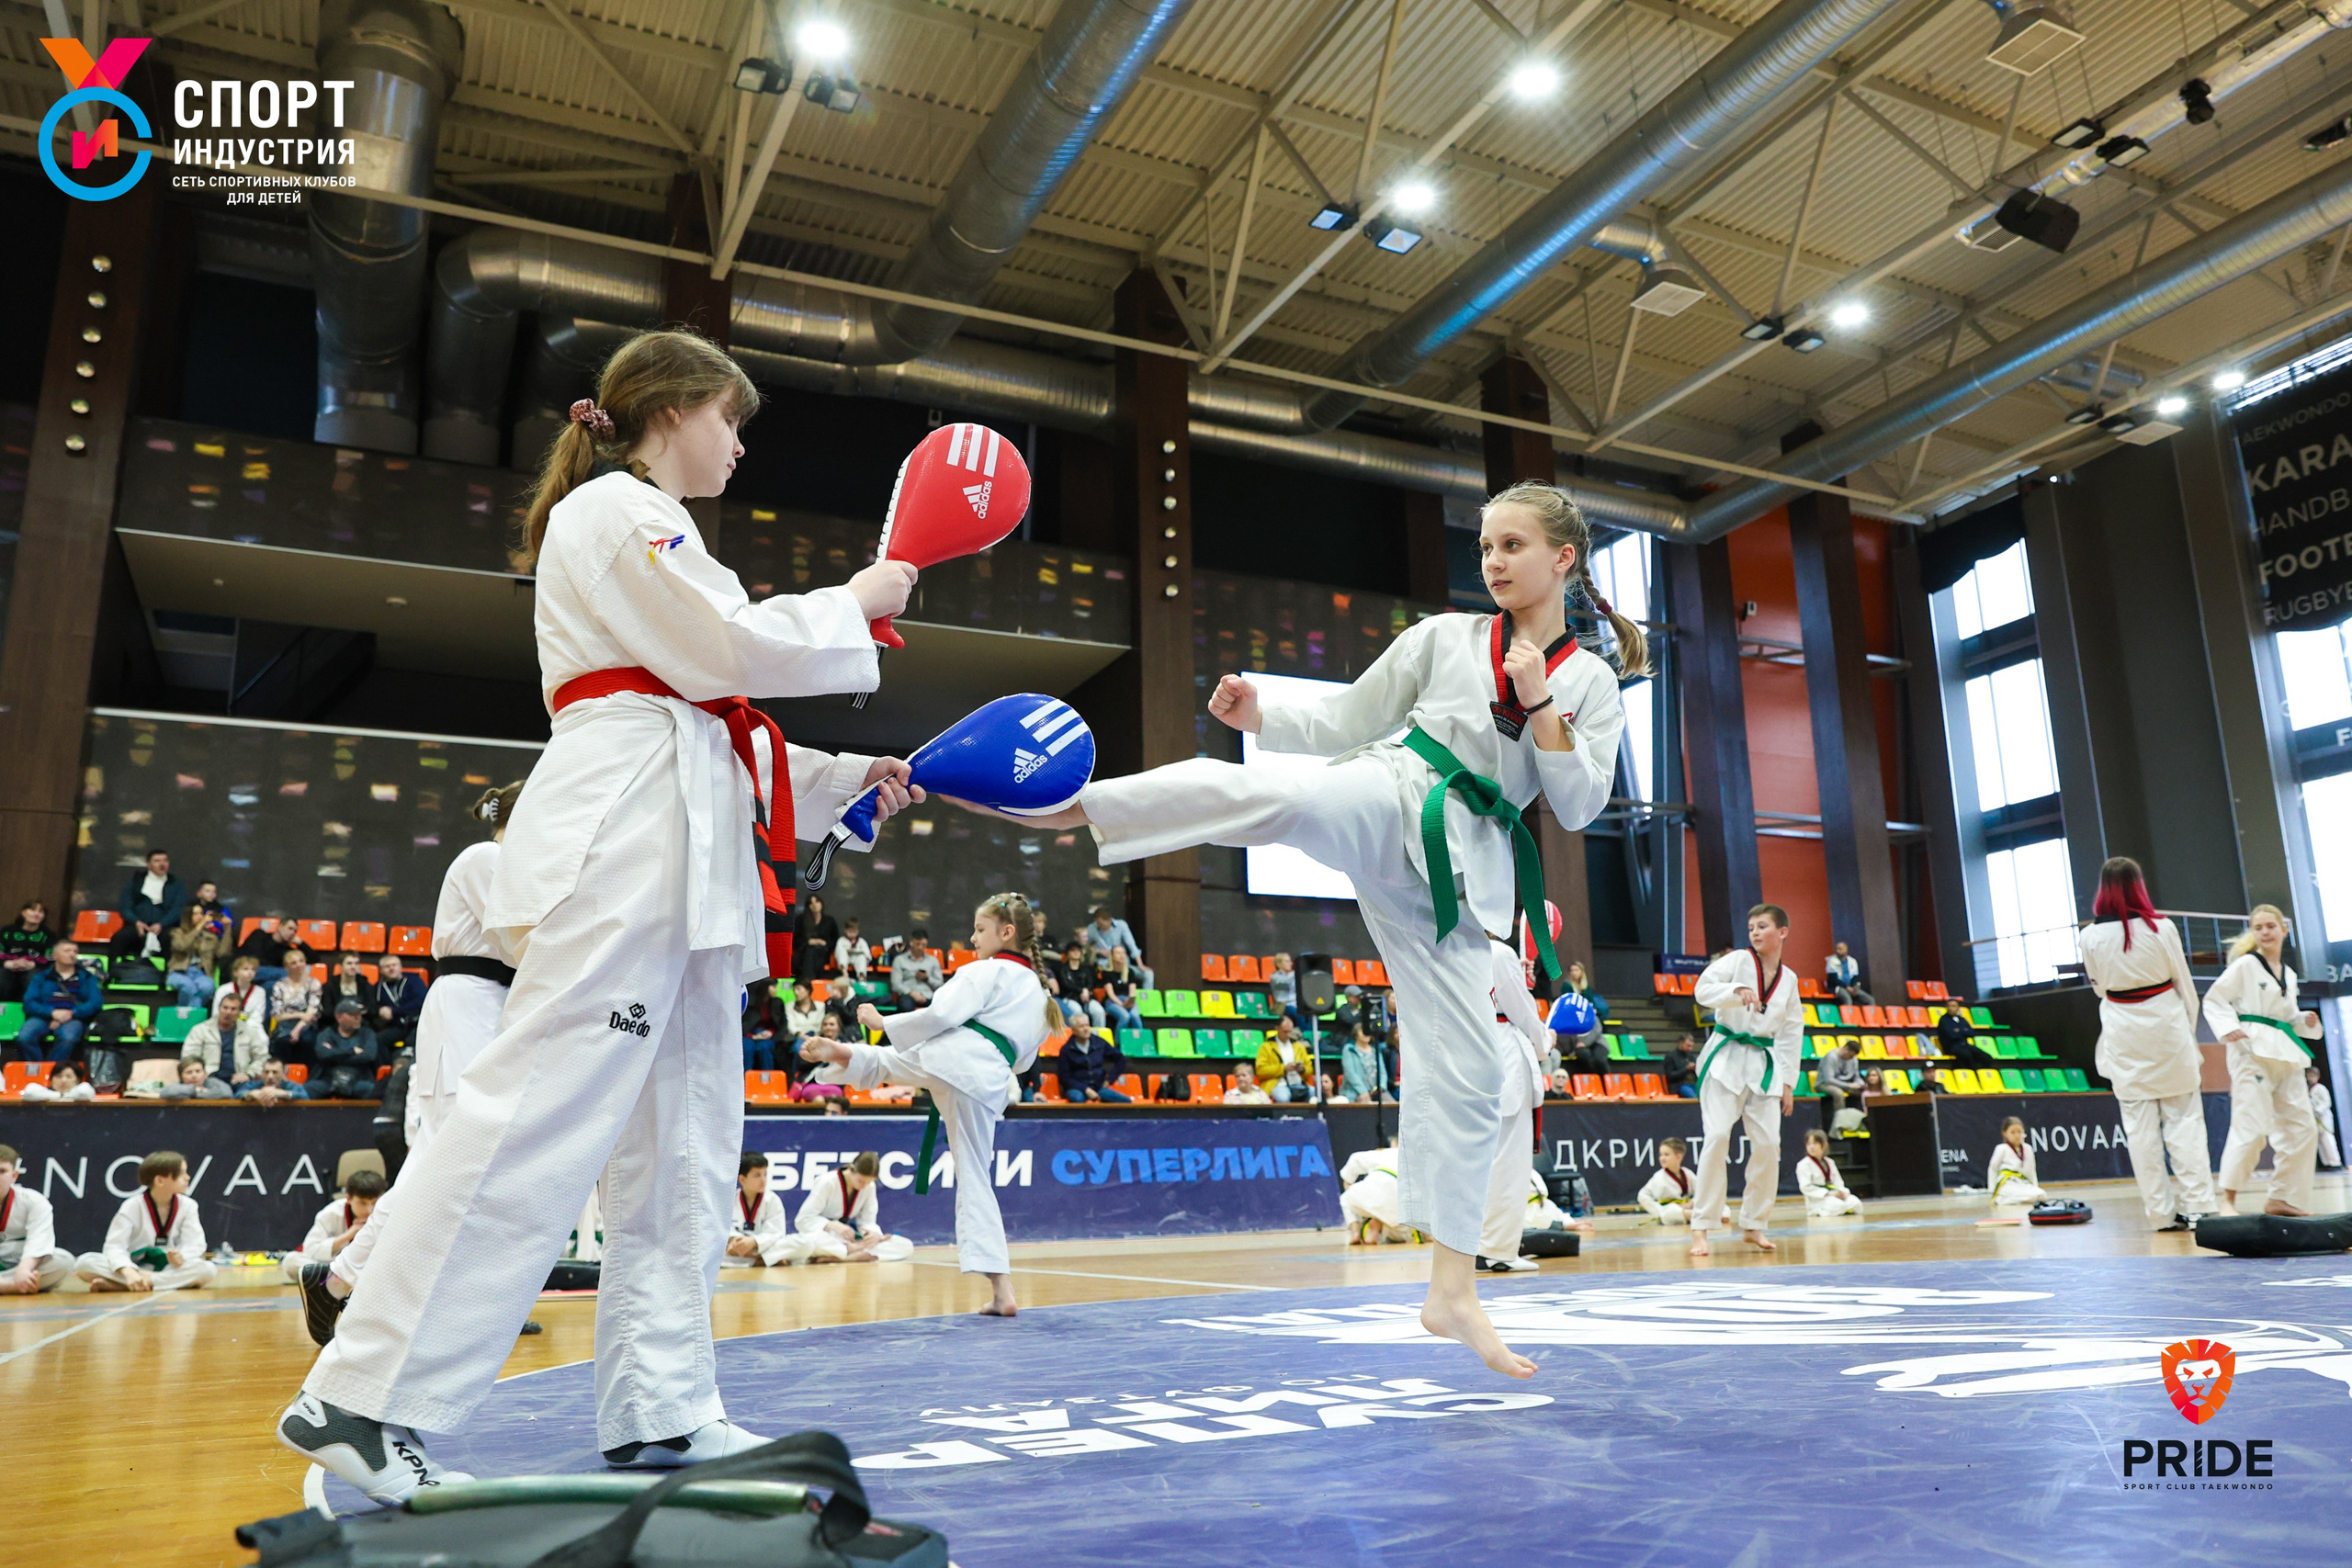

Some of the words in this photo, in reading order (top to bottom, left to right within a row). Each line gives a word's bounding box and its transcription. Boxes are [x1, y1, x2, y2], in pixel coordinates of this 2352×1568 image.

[2242, 391, 2352, 446] AEKWONDO
[978, 480, 993, 519] adidas
[1013, 754, 1048, 784] adidas
[609, 1010, 650, 1038] Daedo
[762, 1150, 1034, 1191] БЕСИИ
[1051, 1145, 1332, 1186] СУПЕРЛИГА
[919, 1385, 1254, 1417] ФУТЗАЛУ
[919, 1378, 1459, 1433] ЛИГА
[849, 1393, 1555, 1470] СУПЕР
